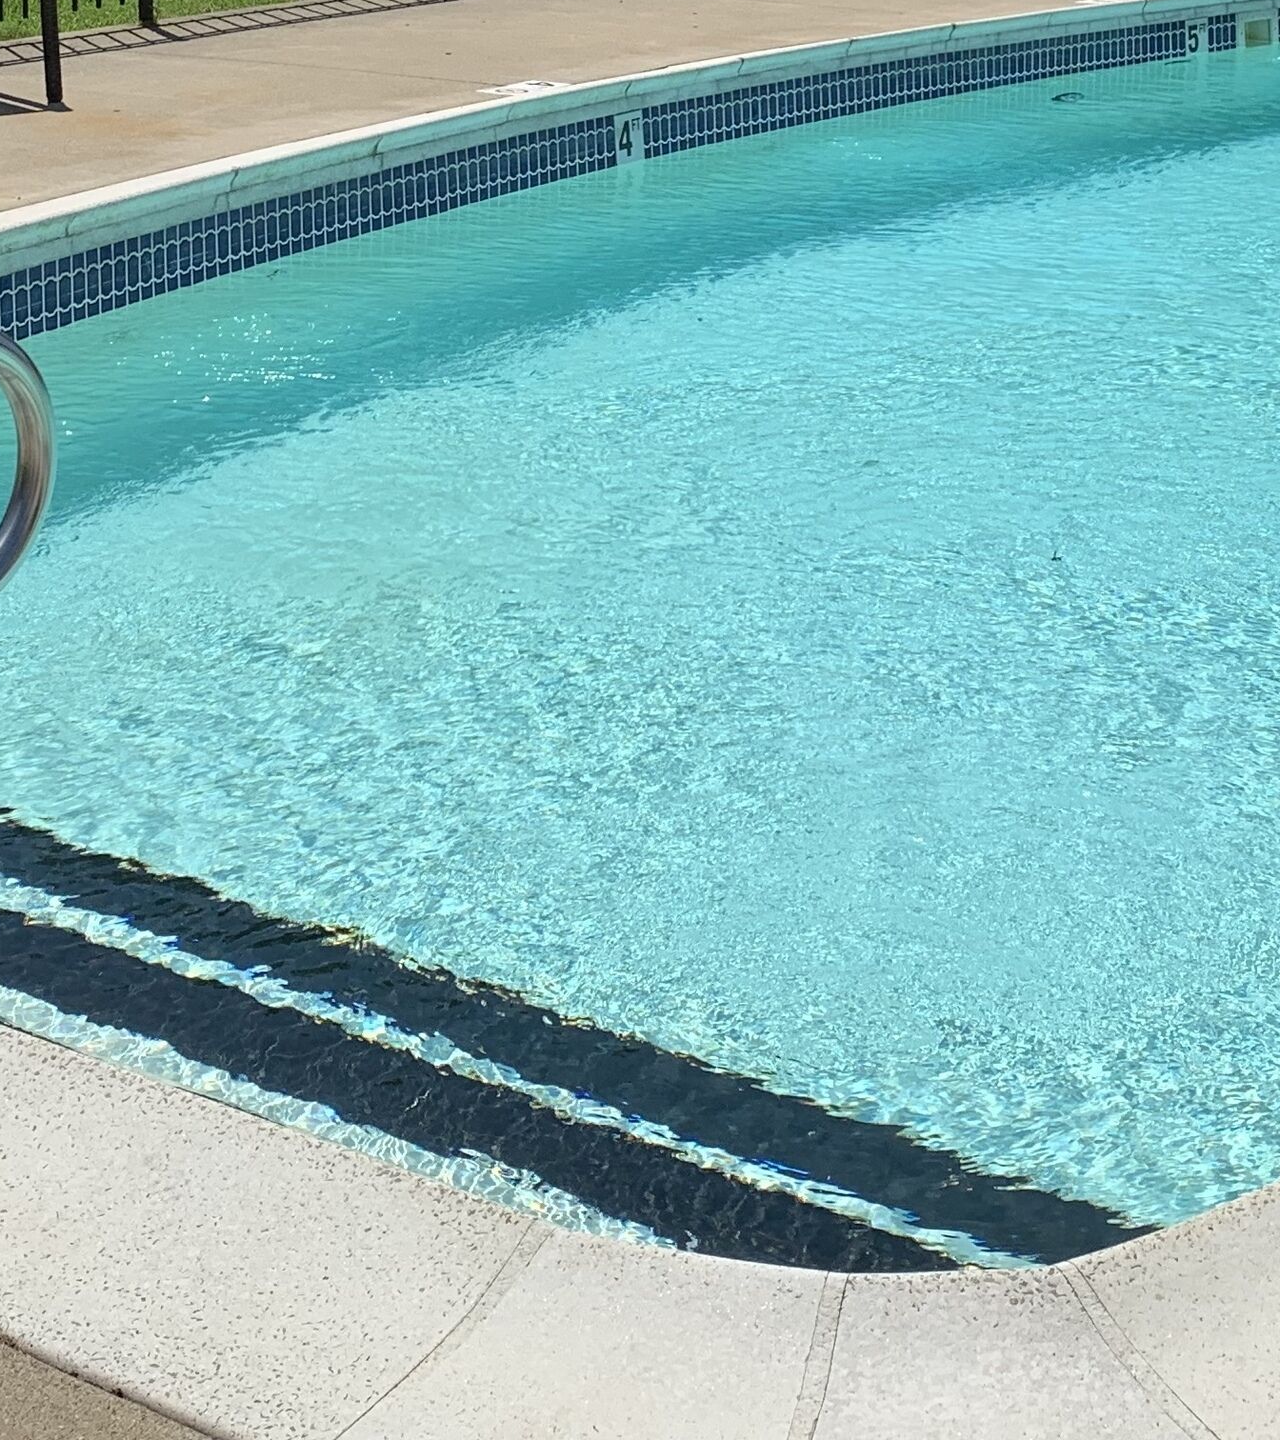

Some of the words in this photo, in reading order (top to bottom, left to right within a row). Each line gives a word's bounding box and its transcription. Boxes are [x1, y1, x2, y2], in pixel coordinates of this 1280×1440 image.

[1188, 24, 1199, 53] 5
[618, 120, 633, 157] 4
[631, 117, 641, 131] FT
